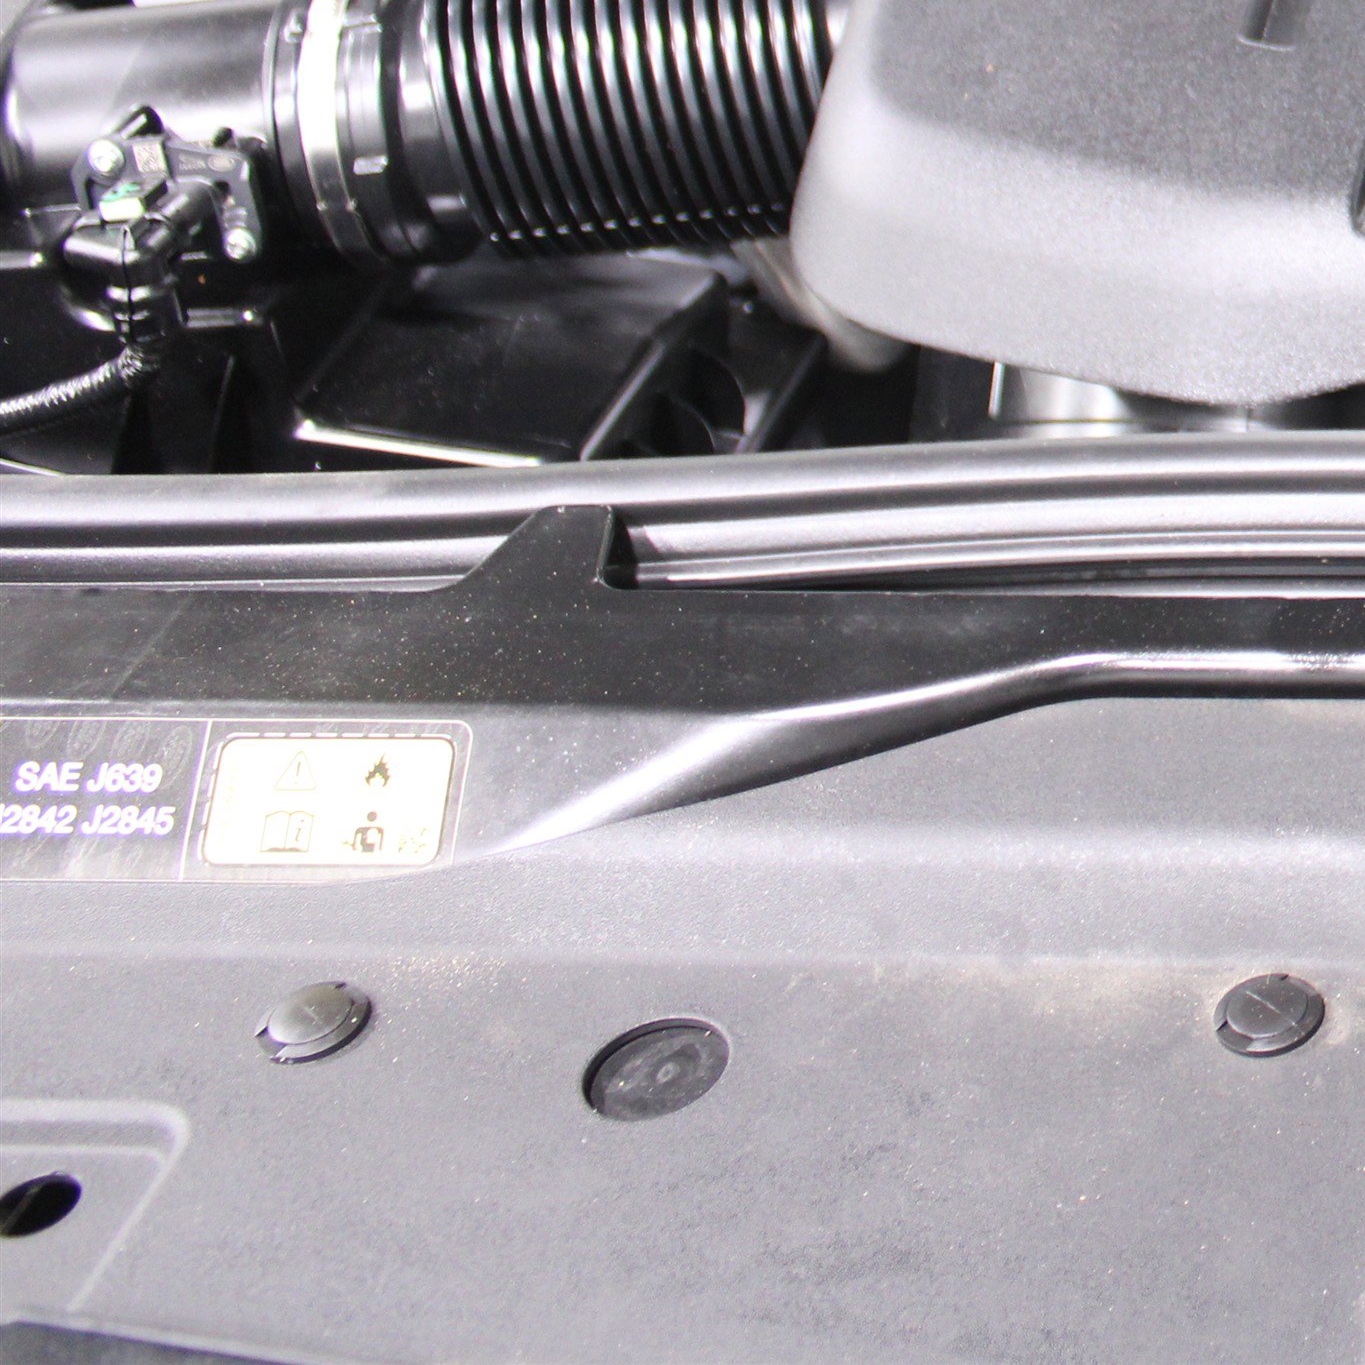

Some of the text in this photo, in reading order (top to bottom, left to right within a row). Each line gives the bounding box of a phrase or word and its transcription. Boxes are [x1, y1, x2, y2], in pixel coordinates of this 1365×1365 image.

[15, 761, 163, 793] SAE J639
[0, 803, 176, 835] 2842 J2845
